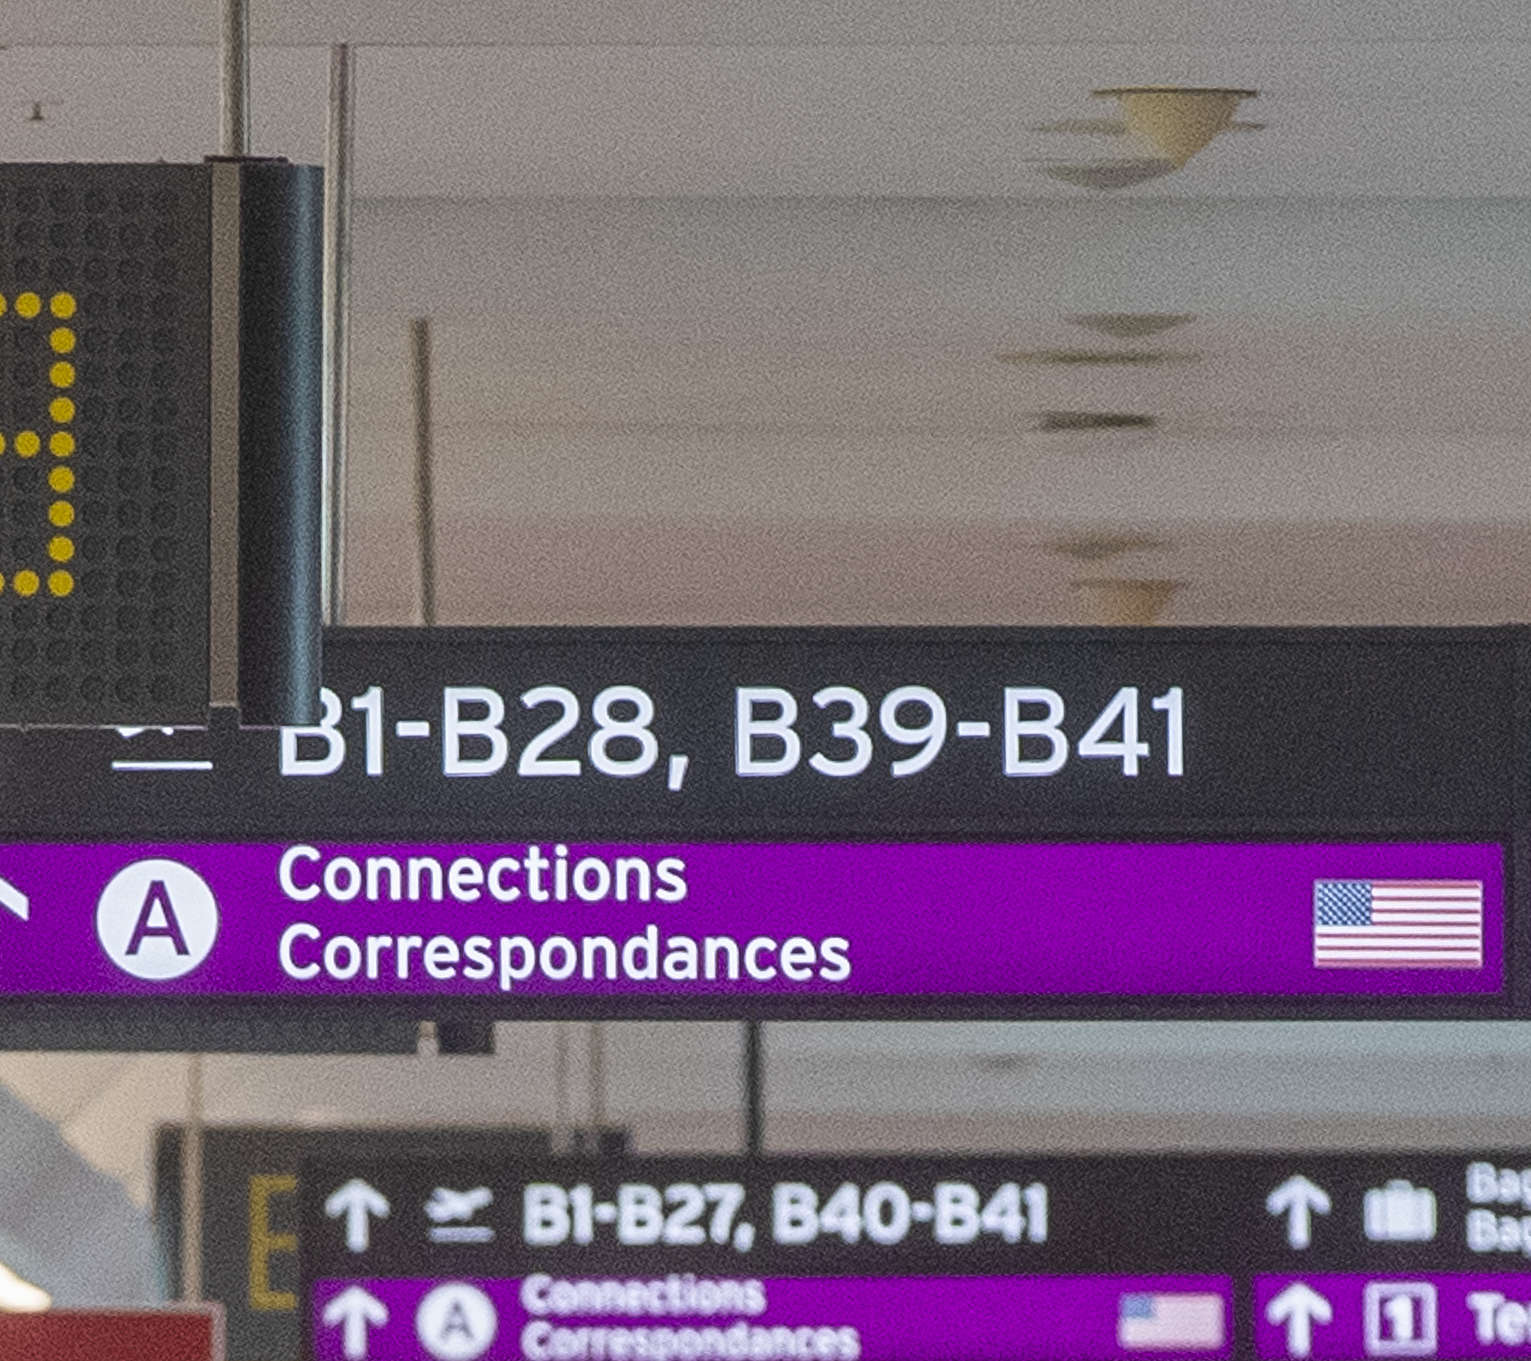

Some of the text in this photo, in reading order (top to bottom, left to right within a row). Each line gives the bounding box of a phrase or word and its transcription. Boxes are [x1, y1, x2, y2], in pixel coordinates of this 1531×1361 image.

[280, 686, 1183, 790] B1-B28, B39-B41
[278, 846, 687, 902] Connections
[124, 876, 193, 965] A
[279, 922, 851, 992] Correspondances
[524, 1182, 1047, 1251] B1-B27, B40-B41
[440, 1297, 471, 1339] A
[522, 1275, 765, 1314] Connections
[1383, 1293, 1413, 1340] 1
